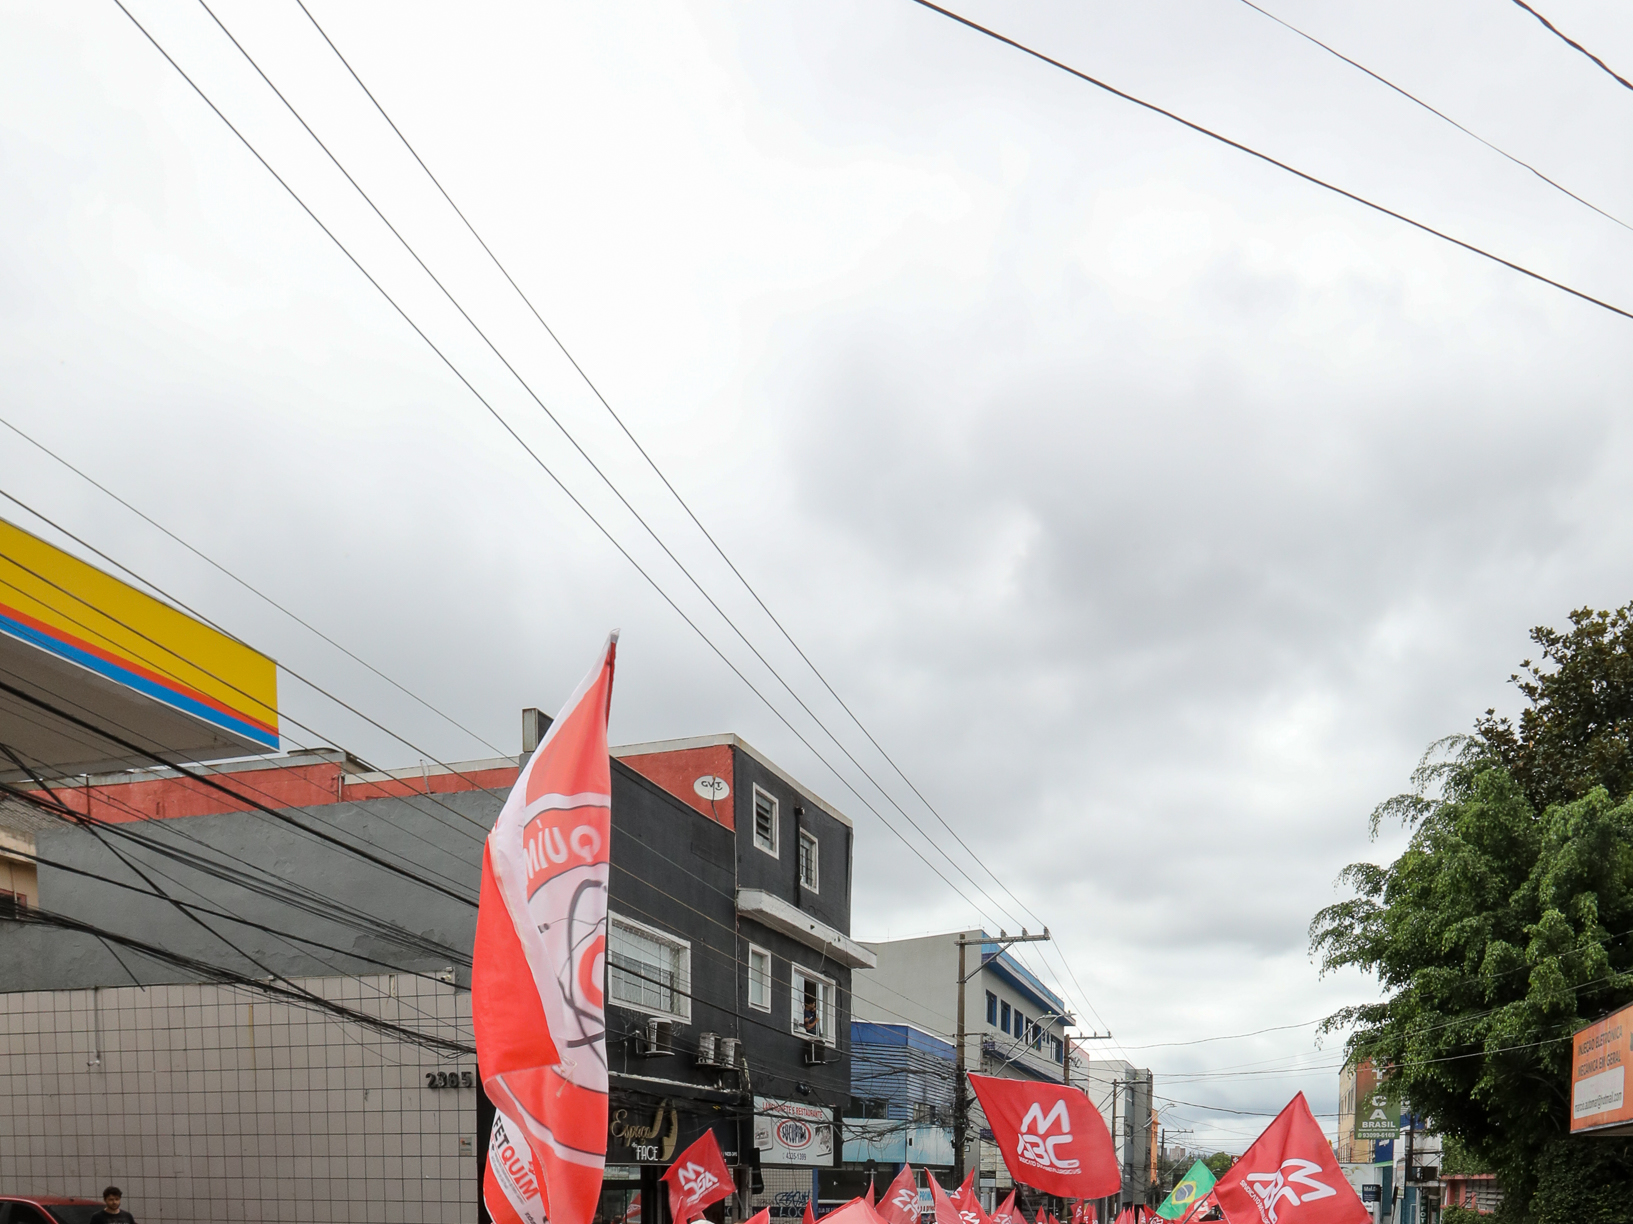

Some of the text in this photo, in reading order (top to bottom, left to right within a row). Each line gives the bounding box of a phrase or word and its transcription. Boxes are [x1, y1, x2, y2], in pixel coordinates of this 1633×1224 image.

[796, 1107, 823, 1119] RESTAURANTE
[494, 1115, 540, 1201] FETQUIM
[636, 1145, 659, 1161] FACE
